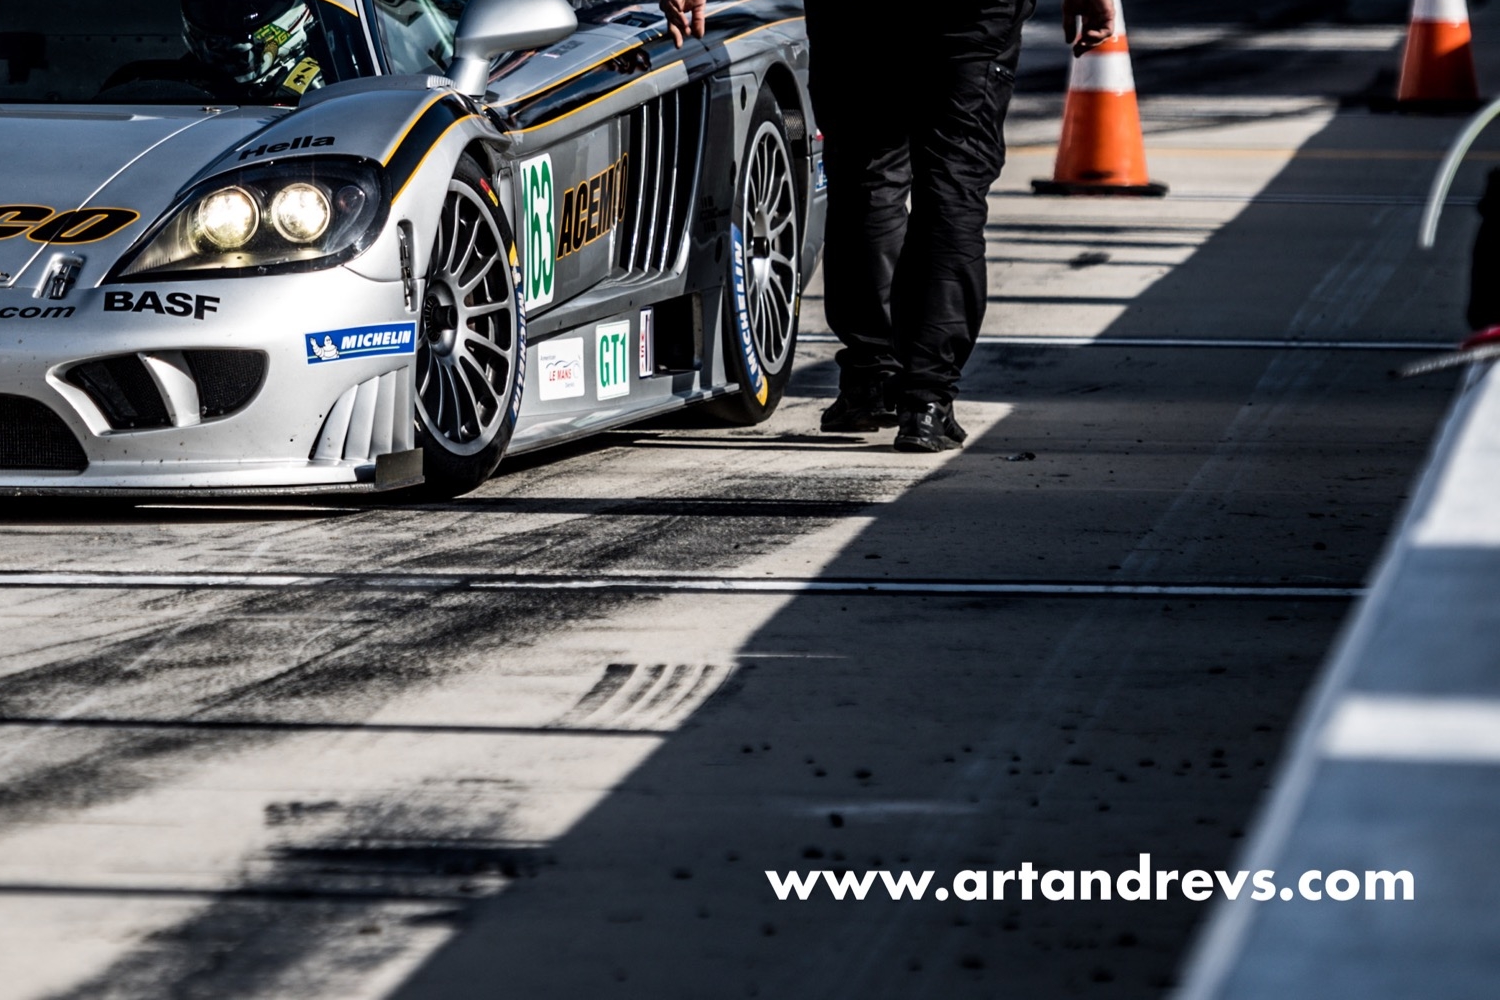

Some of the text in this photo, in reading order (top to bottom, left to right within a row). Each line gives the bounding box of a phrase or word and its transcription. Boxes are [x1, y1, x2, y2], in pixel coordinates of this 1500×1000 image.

[238, 135, 336, 161] Hella
[556, 152, 629, 262] ACEMCO
[523, 160, 555, 302] 163
[103, 290, 220, 320] BASF
[734, 241, 758, 376] MICHELIN
[341, 329, 412, 350] MICHELIN
[600, 332, 626, 388] GT1
[549, 368, 572, 381] LE MANS
